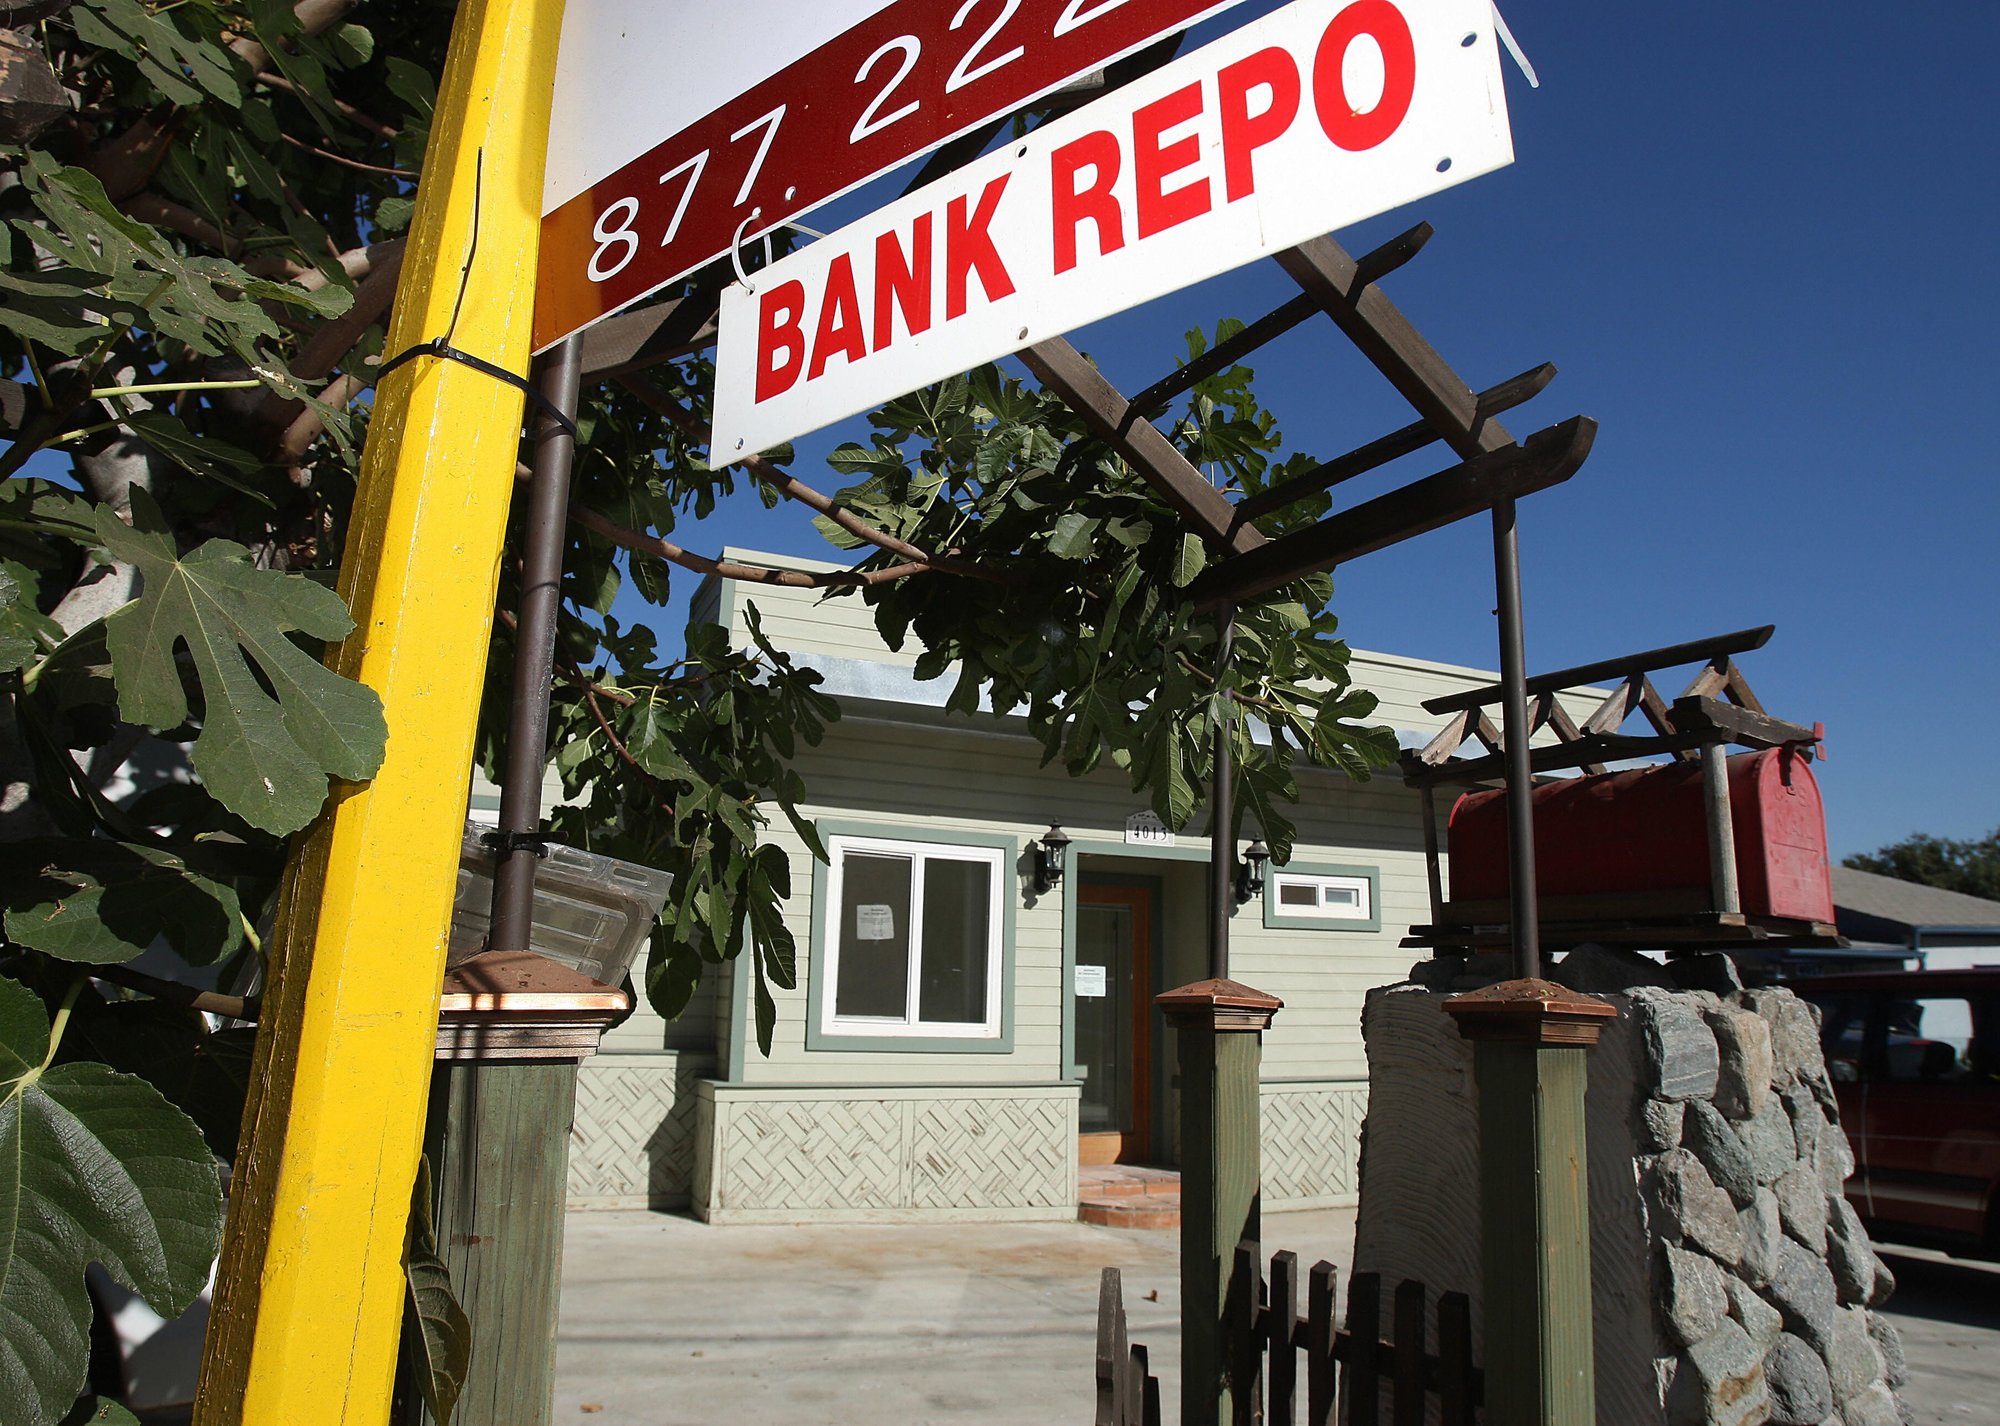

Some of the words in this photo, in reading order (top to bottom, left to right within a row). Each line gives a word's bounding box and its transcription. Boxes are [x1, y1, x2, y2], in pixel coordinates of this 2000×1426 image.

[587, 103, 787, 283] 877
[756, 173, 1015, 402] BANK
[1051, 0, 1416, 275] REPO
